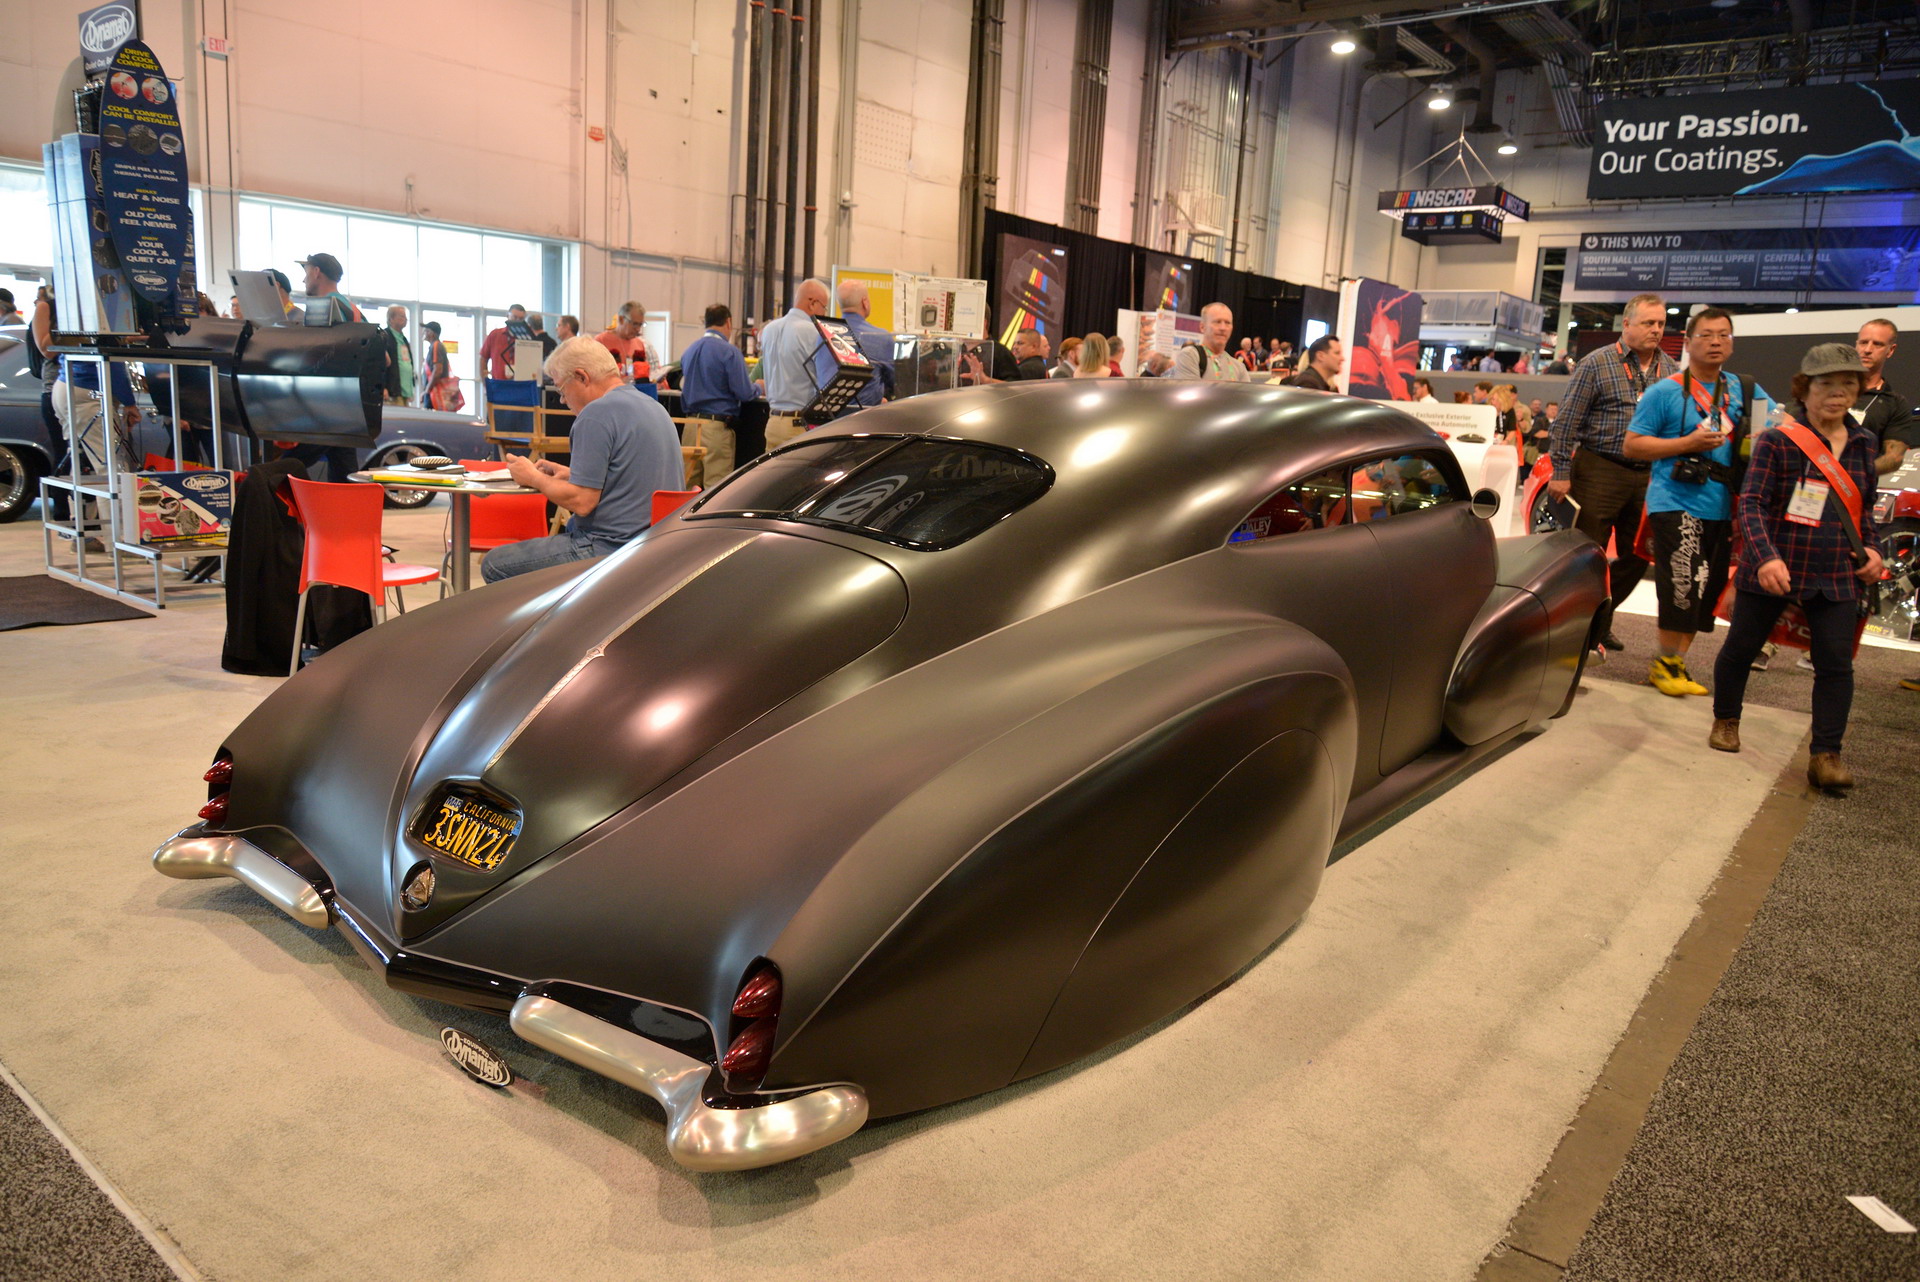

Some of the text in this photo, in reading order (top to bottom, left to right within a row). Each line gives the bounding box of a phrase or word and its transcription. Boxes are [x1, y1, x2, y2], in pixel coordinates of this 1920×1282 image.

[86, 13, 130, 50] Dynamat
[209, 37, 225, 52] EXIT
[124, 48, 150, 57] DRIVE
[116, 59, 160, 71] COMFORT
[131, 55, 155, 64] COOL
[103, 110, 123, 118] CAN
[136, 114, 179, 127] INSTALLED
[107, 105, 174, 120] COOL COMFORT
[1604, 109, 1809, 143] Your Passion.
[1599, 145, 1784, 175] Our Coatings.
[114, 163, 136, 171] SIMPLE
[113, 170, 178, 182] THERMAL INSULATION
[113, 191, 139, 200] HEAT
[152, 195, 180, 205] NOISE
[1413, 189, 1477, 207] NASCAR
[124, 210, 172, 221] OLD CARS
[119, 218, 177, 230] FEEL NEWER
[136, 240, 164, 249] YOUR
[1600, 235, 1682, 248] THIS WAY TO
[132, 247, 159, 256] COOL
[125, 255, 177, 265] QUIET CAR
[1583, 255, 1664, 265] SOUTH HALL LOWER
[1671, 254, 1755, 264] SOUTH HALL UPPER
[1764, 253, 1806, 263] CENTRAL
[1416, 412, 1472, 421] Exclusive Exterior
[1441, 421, 1478, 429] Automotive
[186, 476, 225, 489] Dynamat
[463, 801, 516, 831] CALIFORNIA
[424, 807, 515, 869] 3SNN24
[463, 1037, 490, 1058] EQUIPPED
[447, 1031, 502, 1081] Dynamat
